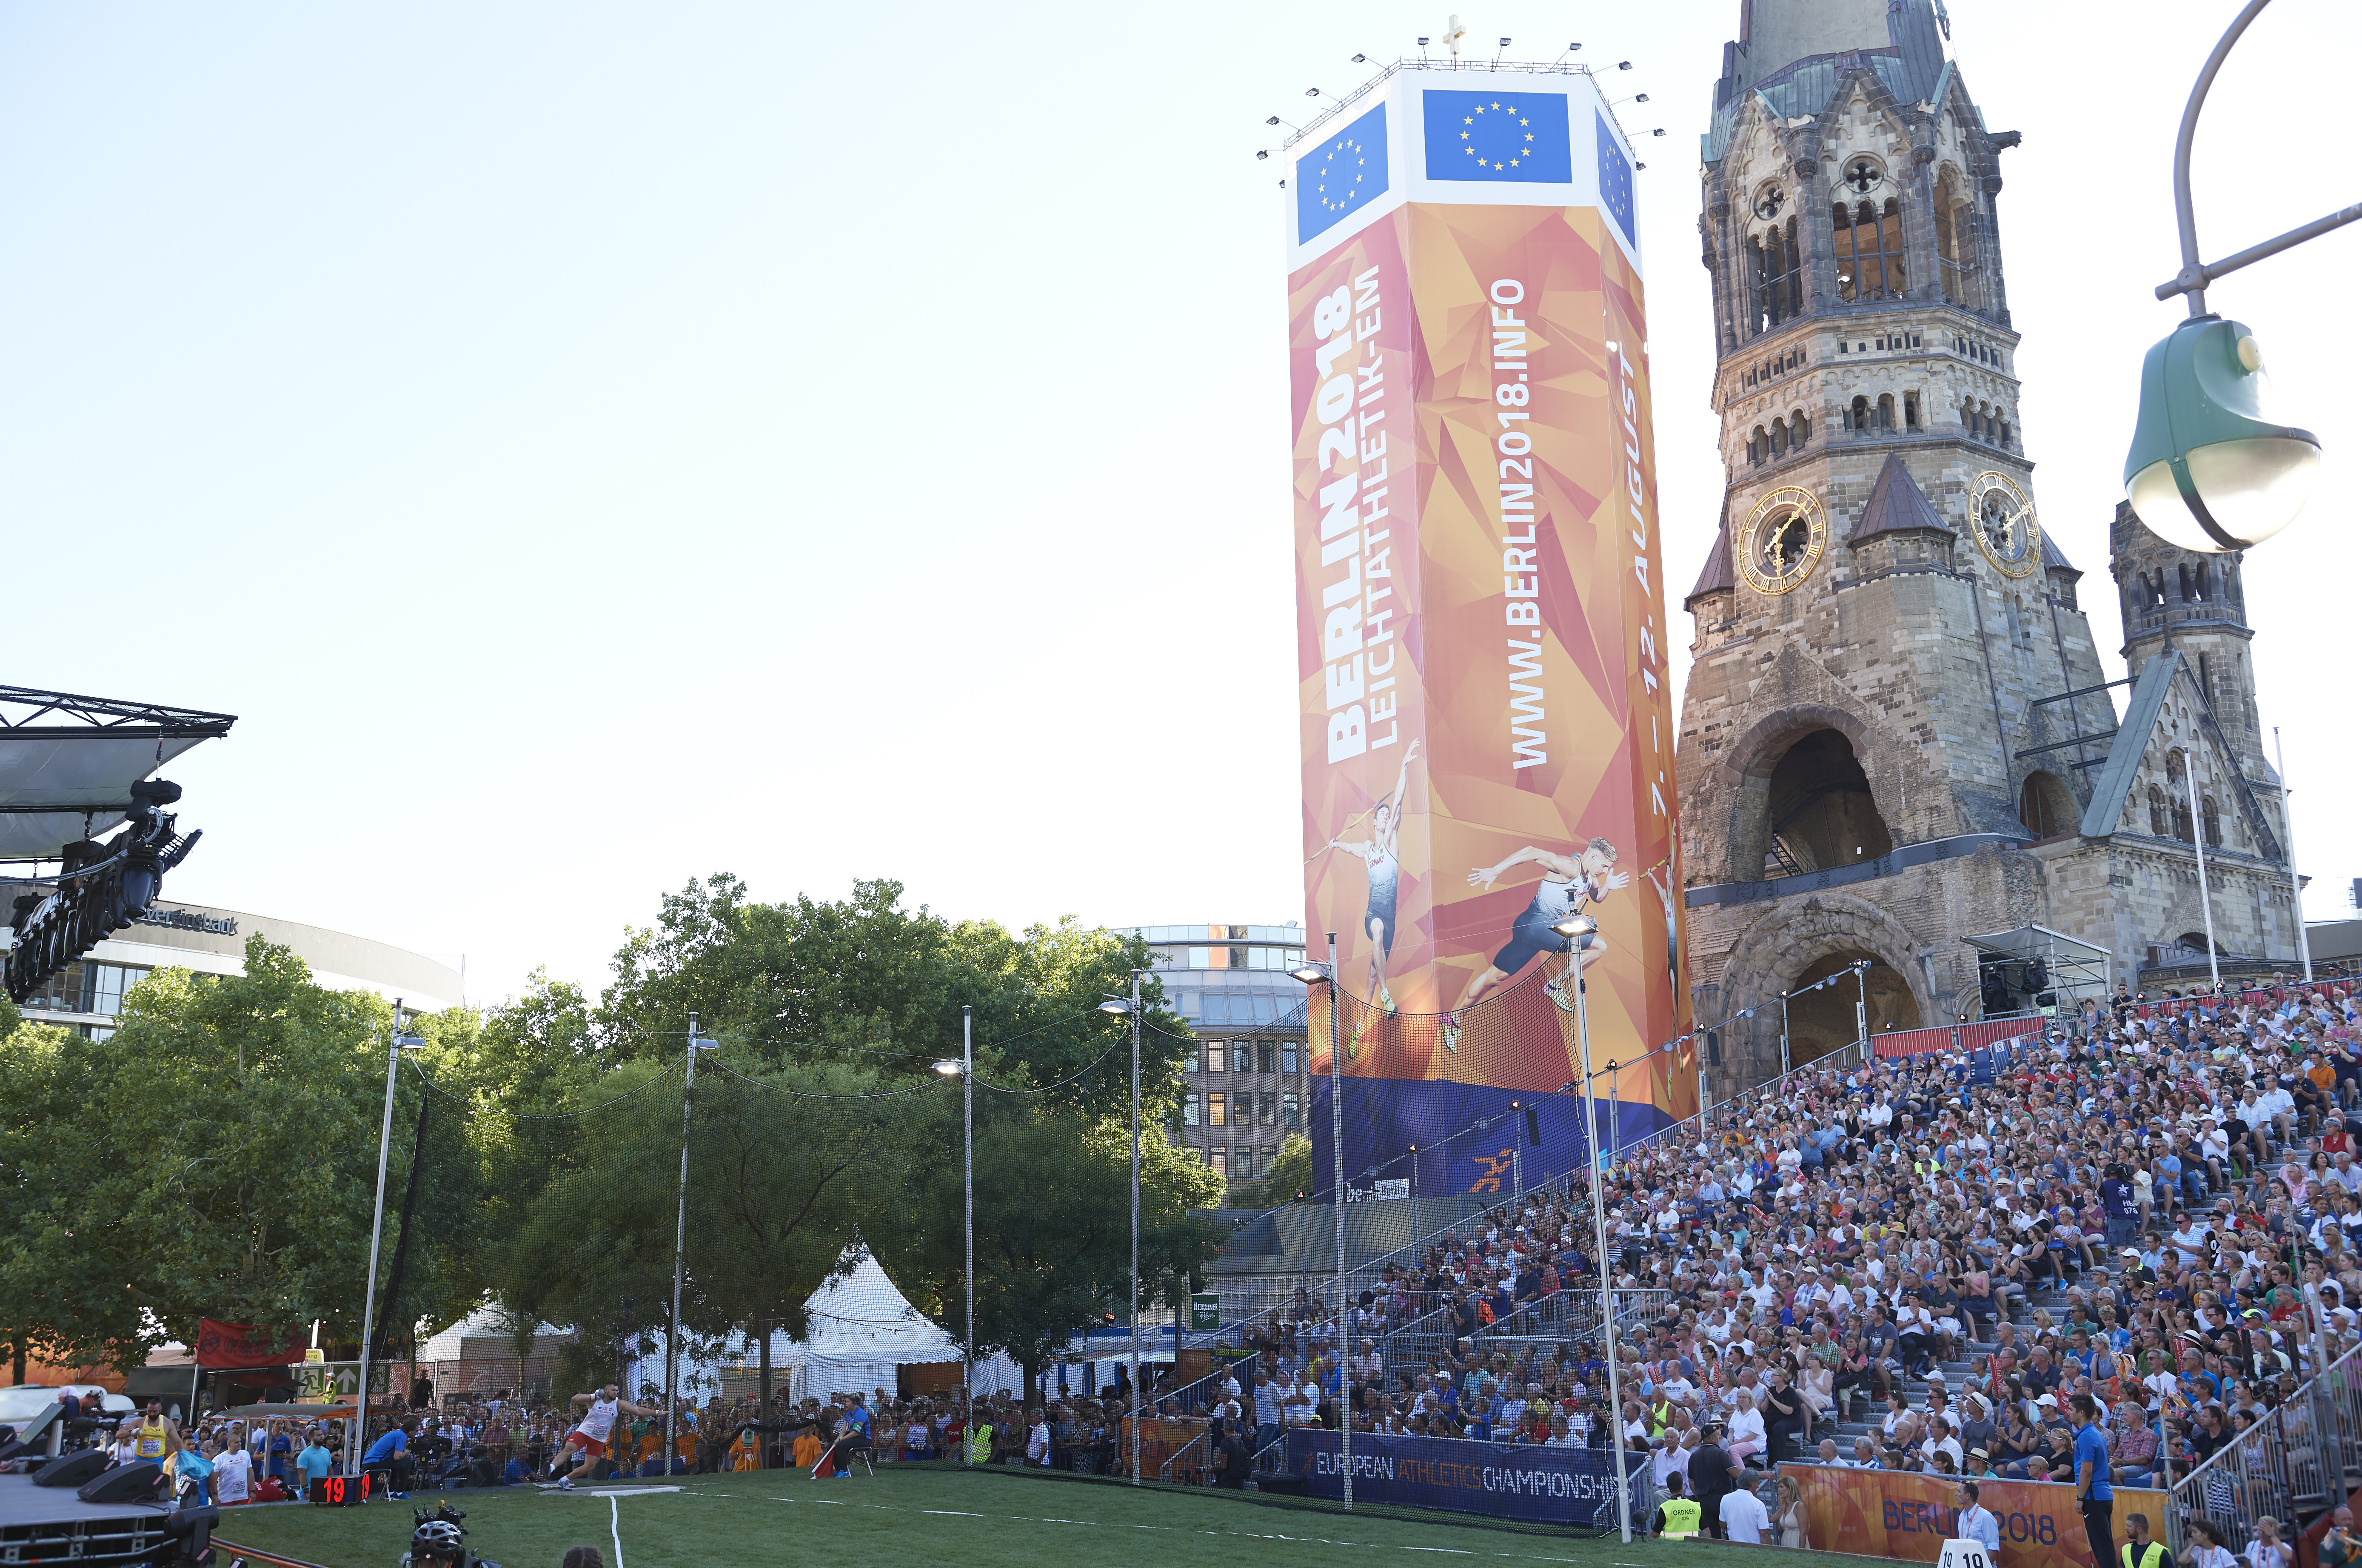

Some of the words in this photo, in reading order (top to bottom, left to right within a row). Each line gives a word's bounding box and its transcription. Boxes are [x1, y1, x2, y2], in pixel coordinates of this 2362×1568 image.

[1619, 340, 1651, 599] AUGUST
[1355, 265, 1398, 750] LEICHTATHLETIK-EM
[1314, 285, 1366, 764] BERLIN2018
[1491, 279, 1547, 770] WWW.BERLIN2018.INFO
[136, 904, 239, 935] Vereinsbank
[1194, 1302, 1218, 1311] BERLINER
[1126, 1436, 1170, 1460] BRLIN
[362, 1474, 370, 1499] 19
[1398, 1458, 1481, 1489] ATHLETICS
[324, 1477, 344, 1502] 19
[1991, 1511, 2057, 1546] 2018
[1943, 1551, 1952, 1568] 19
[1963, 1553, 1983, 1568] 19
